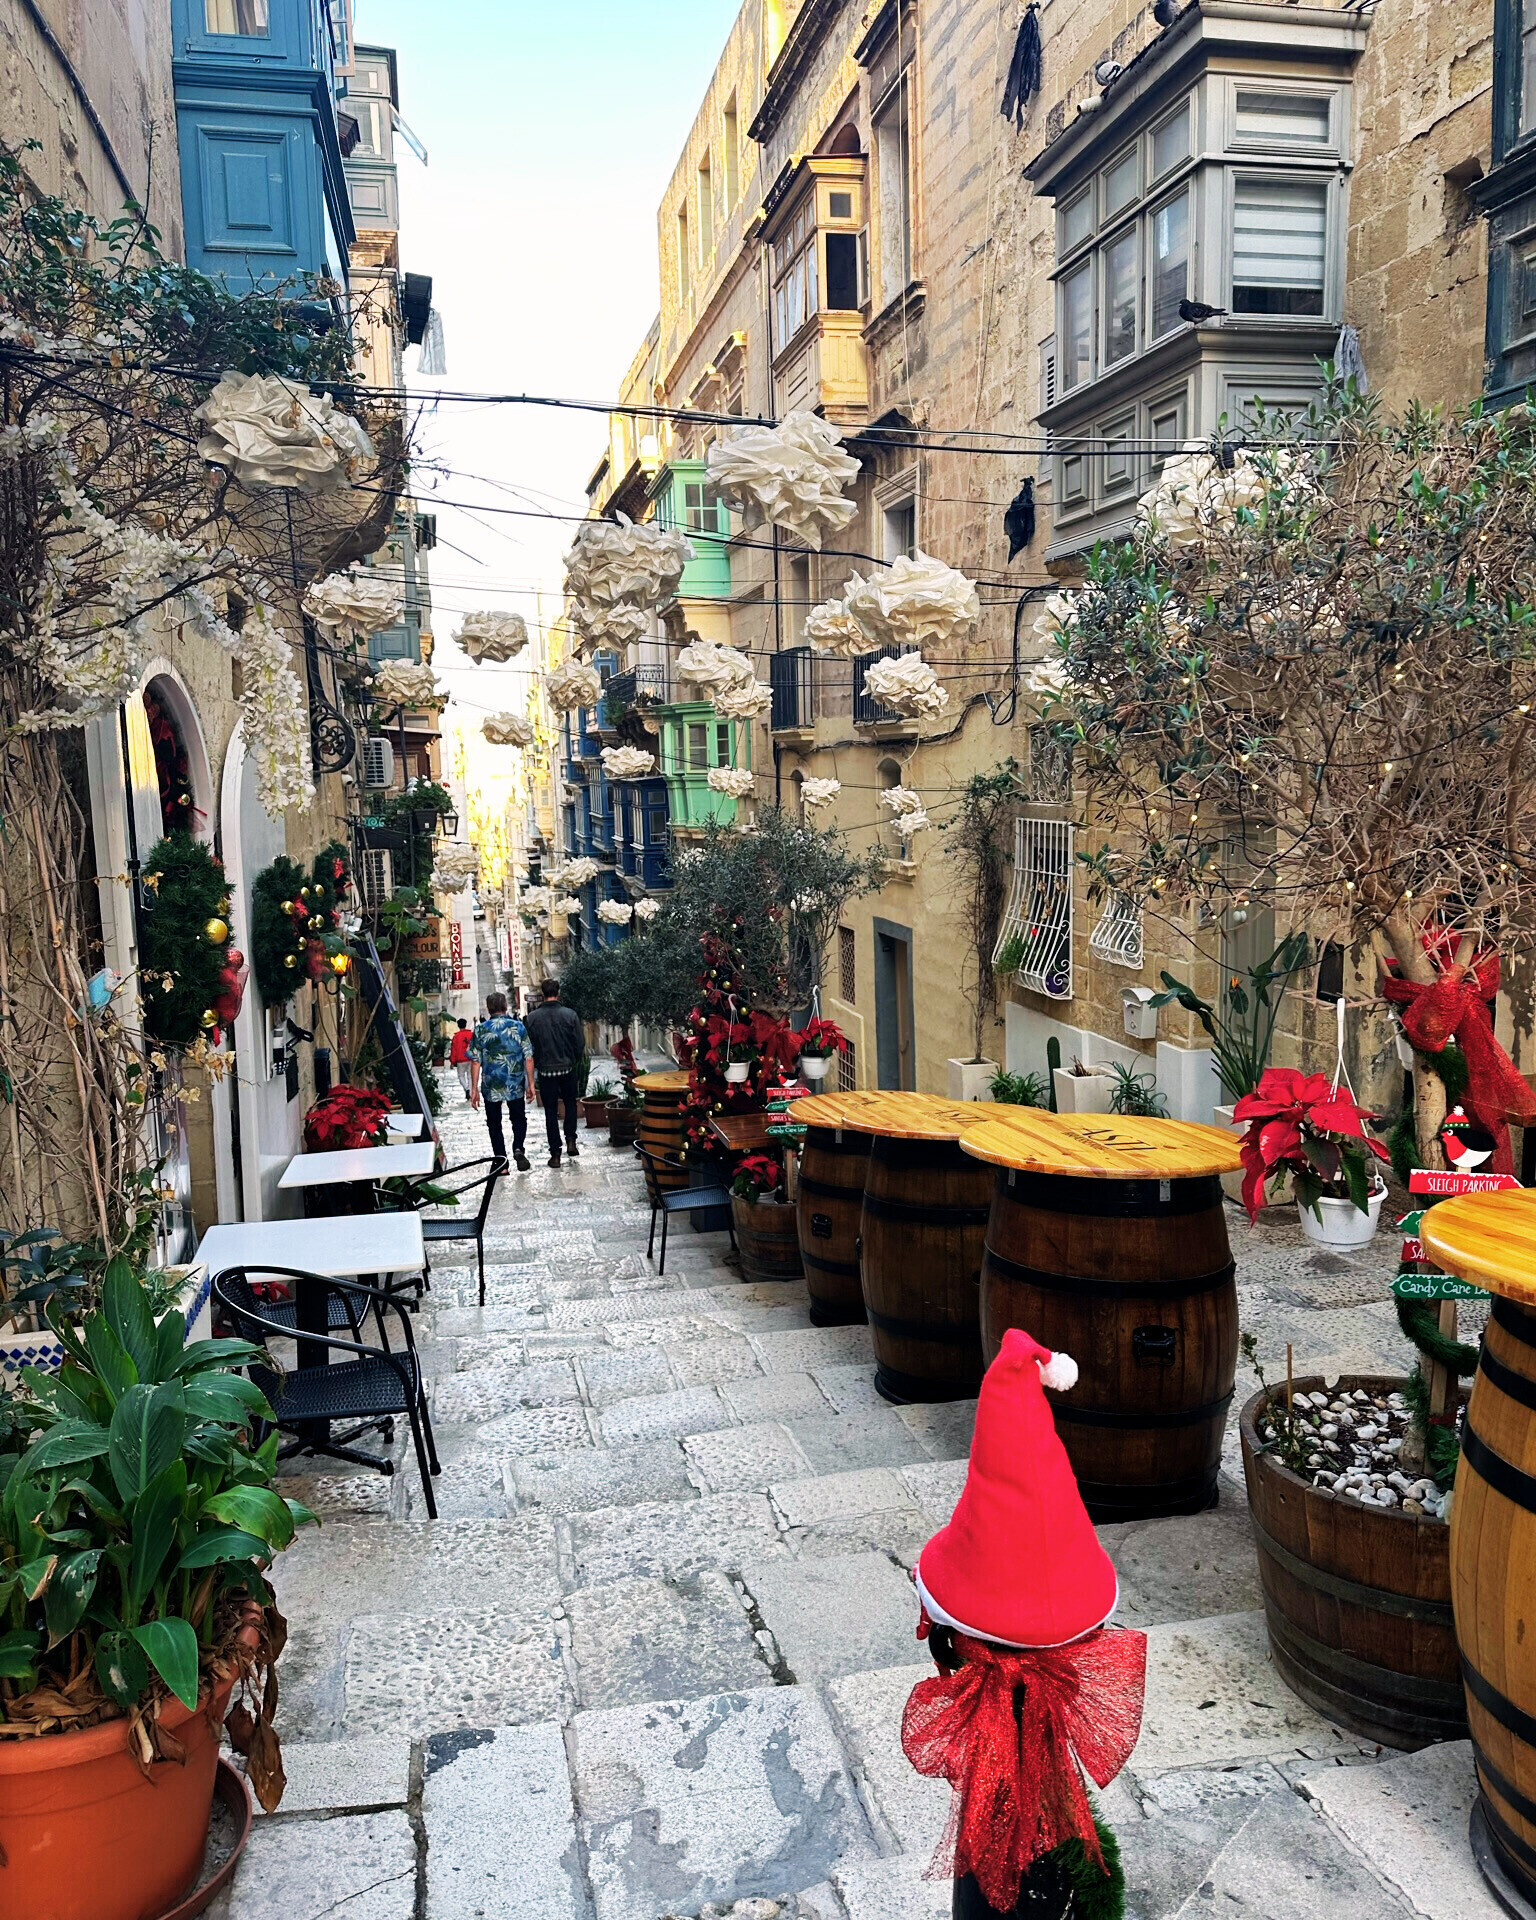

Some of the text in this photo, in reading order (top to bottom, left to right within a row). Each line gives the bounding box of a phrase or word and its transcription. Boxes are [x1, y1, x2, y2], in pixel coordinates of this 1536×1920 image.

[450, 923, 462, 980] BONACI
[512, 923, 521, 974] HARBOUR
[1082, 1128, 1158, 1151] ASTI
[1427, 1178, 1459, 1192] SLEIGH
[1399, 1280, 1438, 1298] Candy
[1441, 1281, 1472, 1295] Cane
